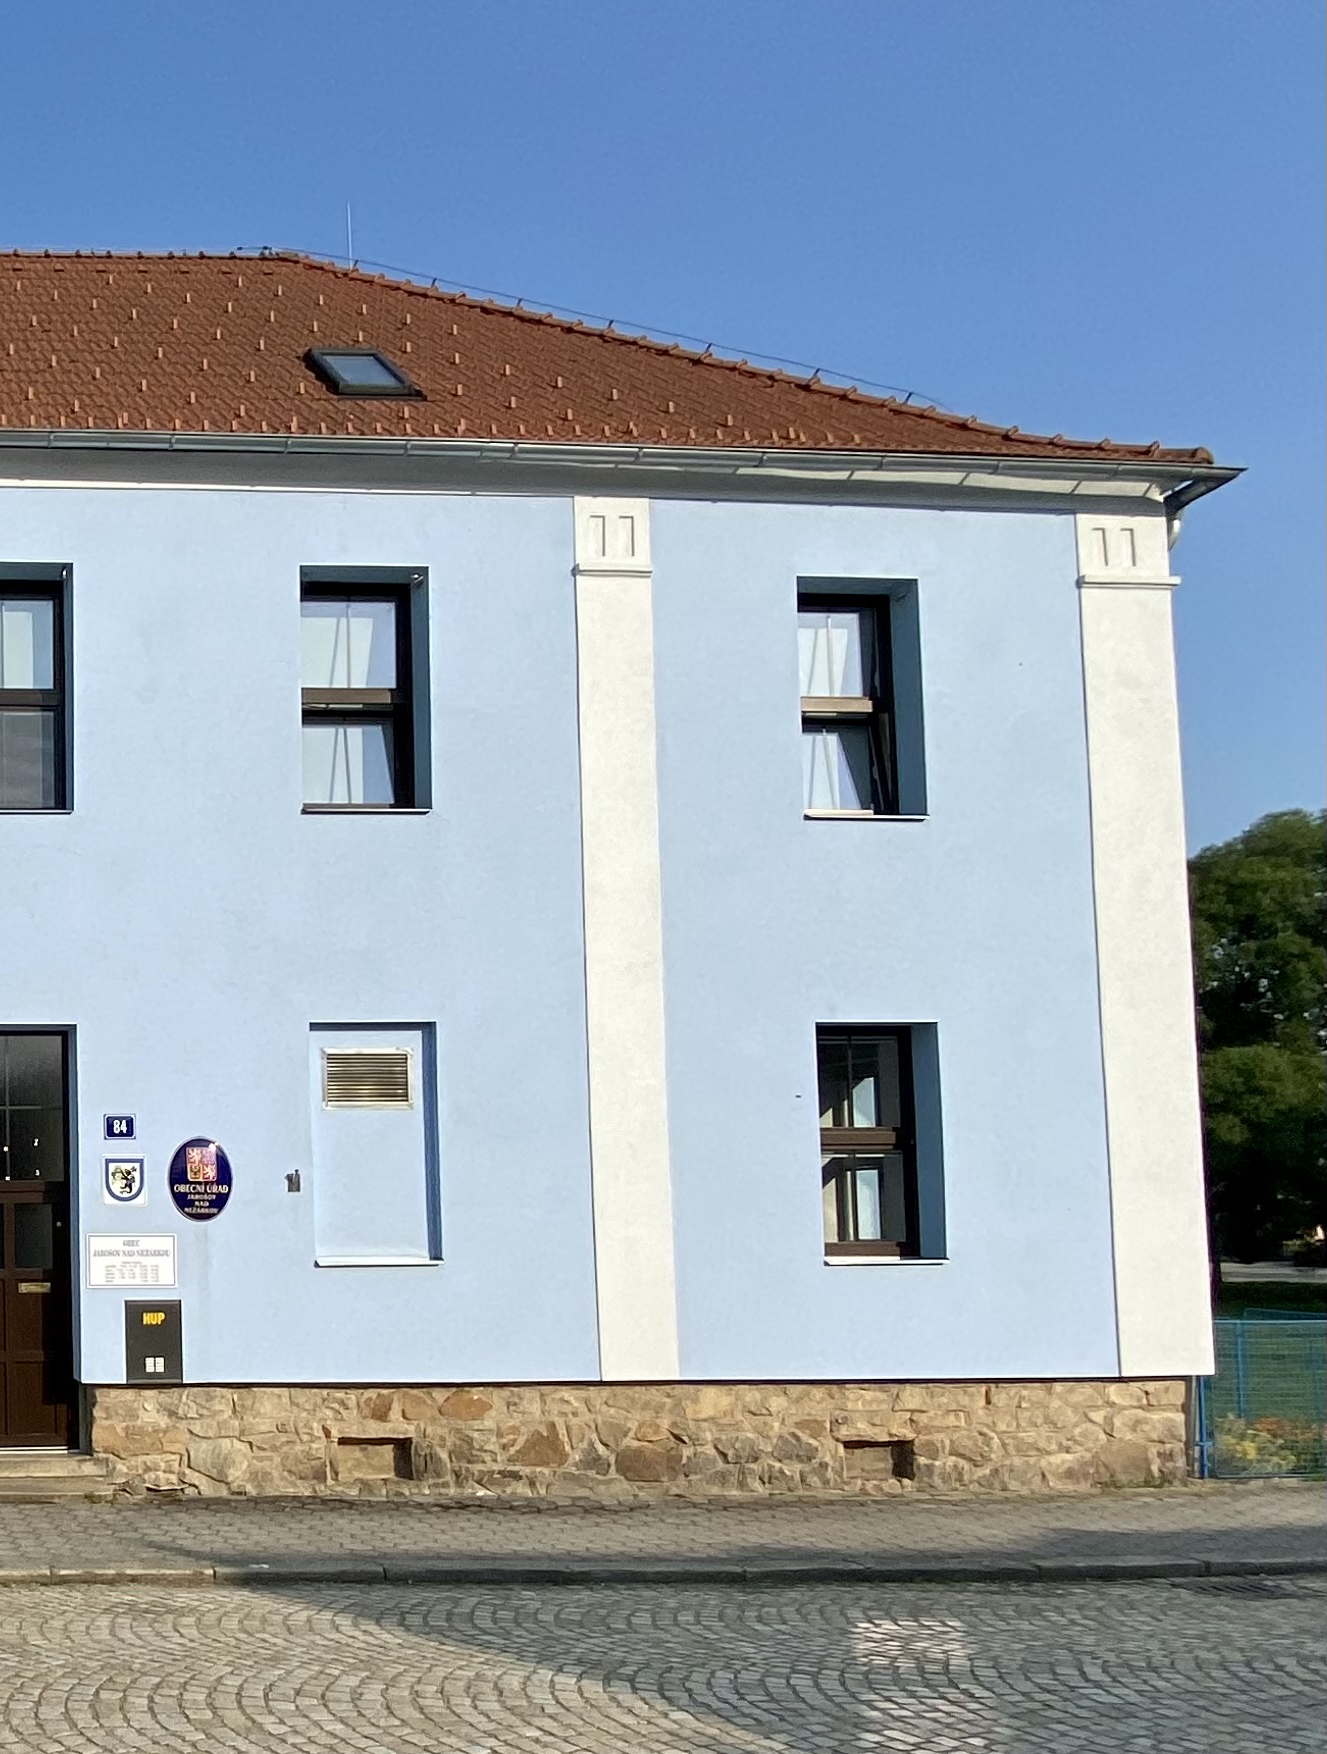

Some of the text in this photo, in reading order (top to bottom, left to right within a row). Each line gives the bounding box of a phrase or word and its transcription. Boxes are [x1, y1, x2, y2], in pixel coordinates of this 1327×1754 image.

[113, 1119, 127, 1134] 84
[174, 1182, 229, 1193] OBECNÍ ÚŘAD
[142, 1312, 166, 1325] HUP
